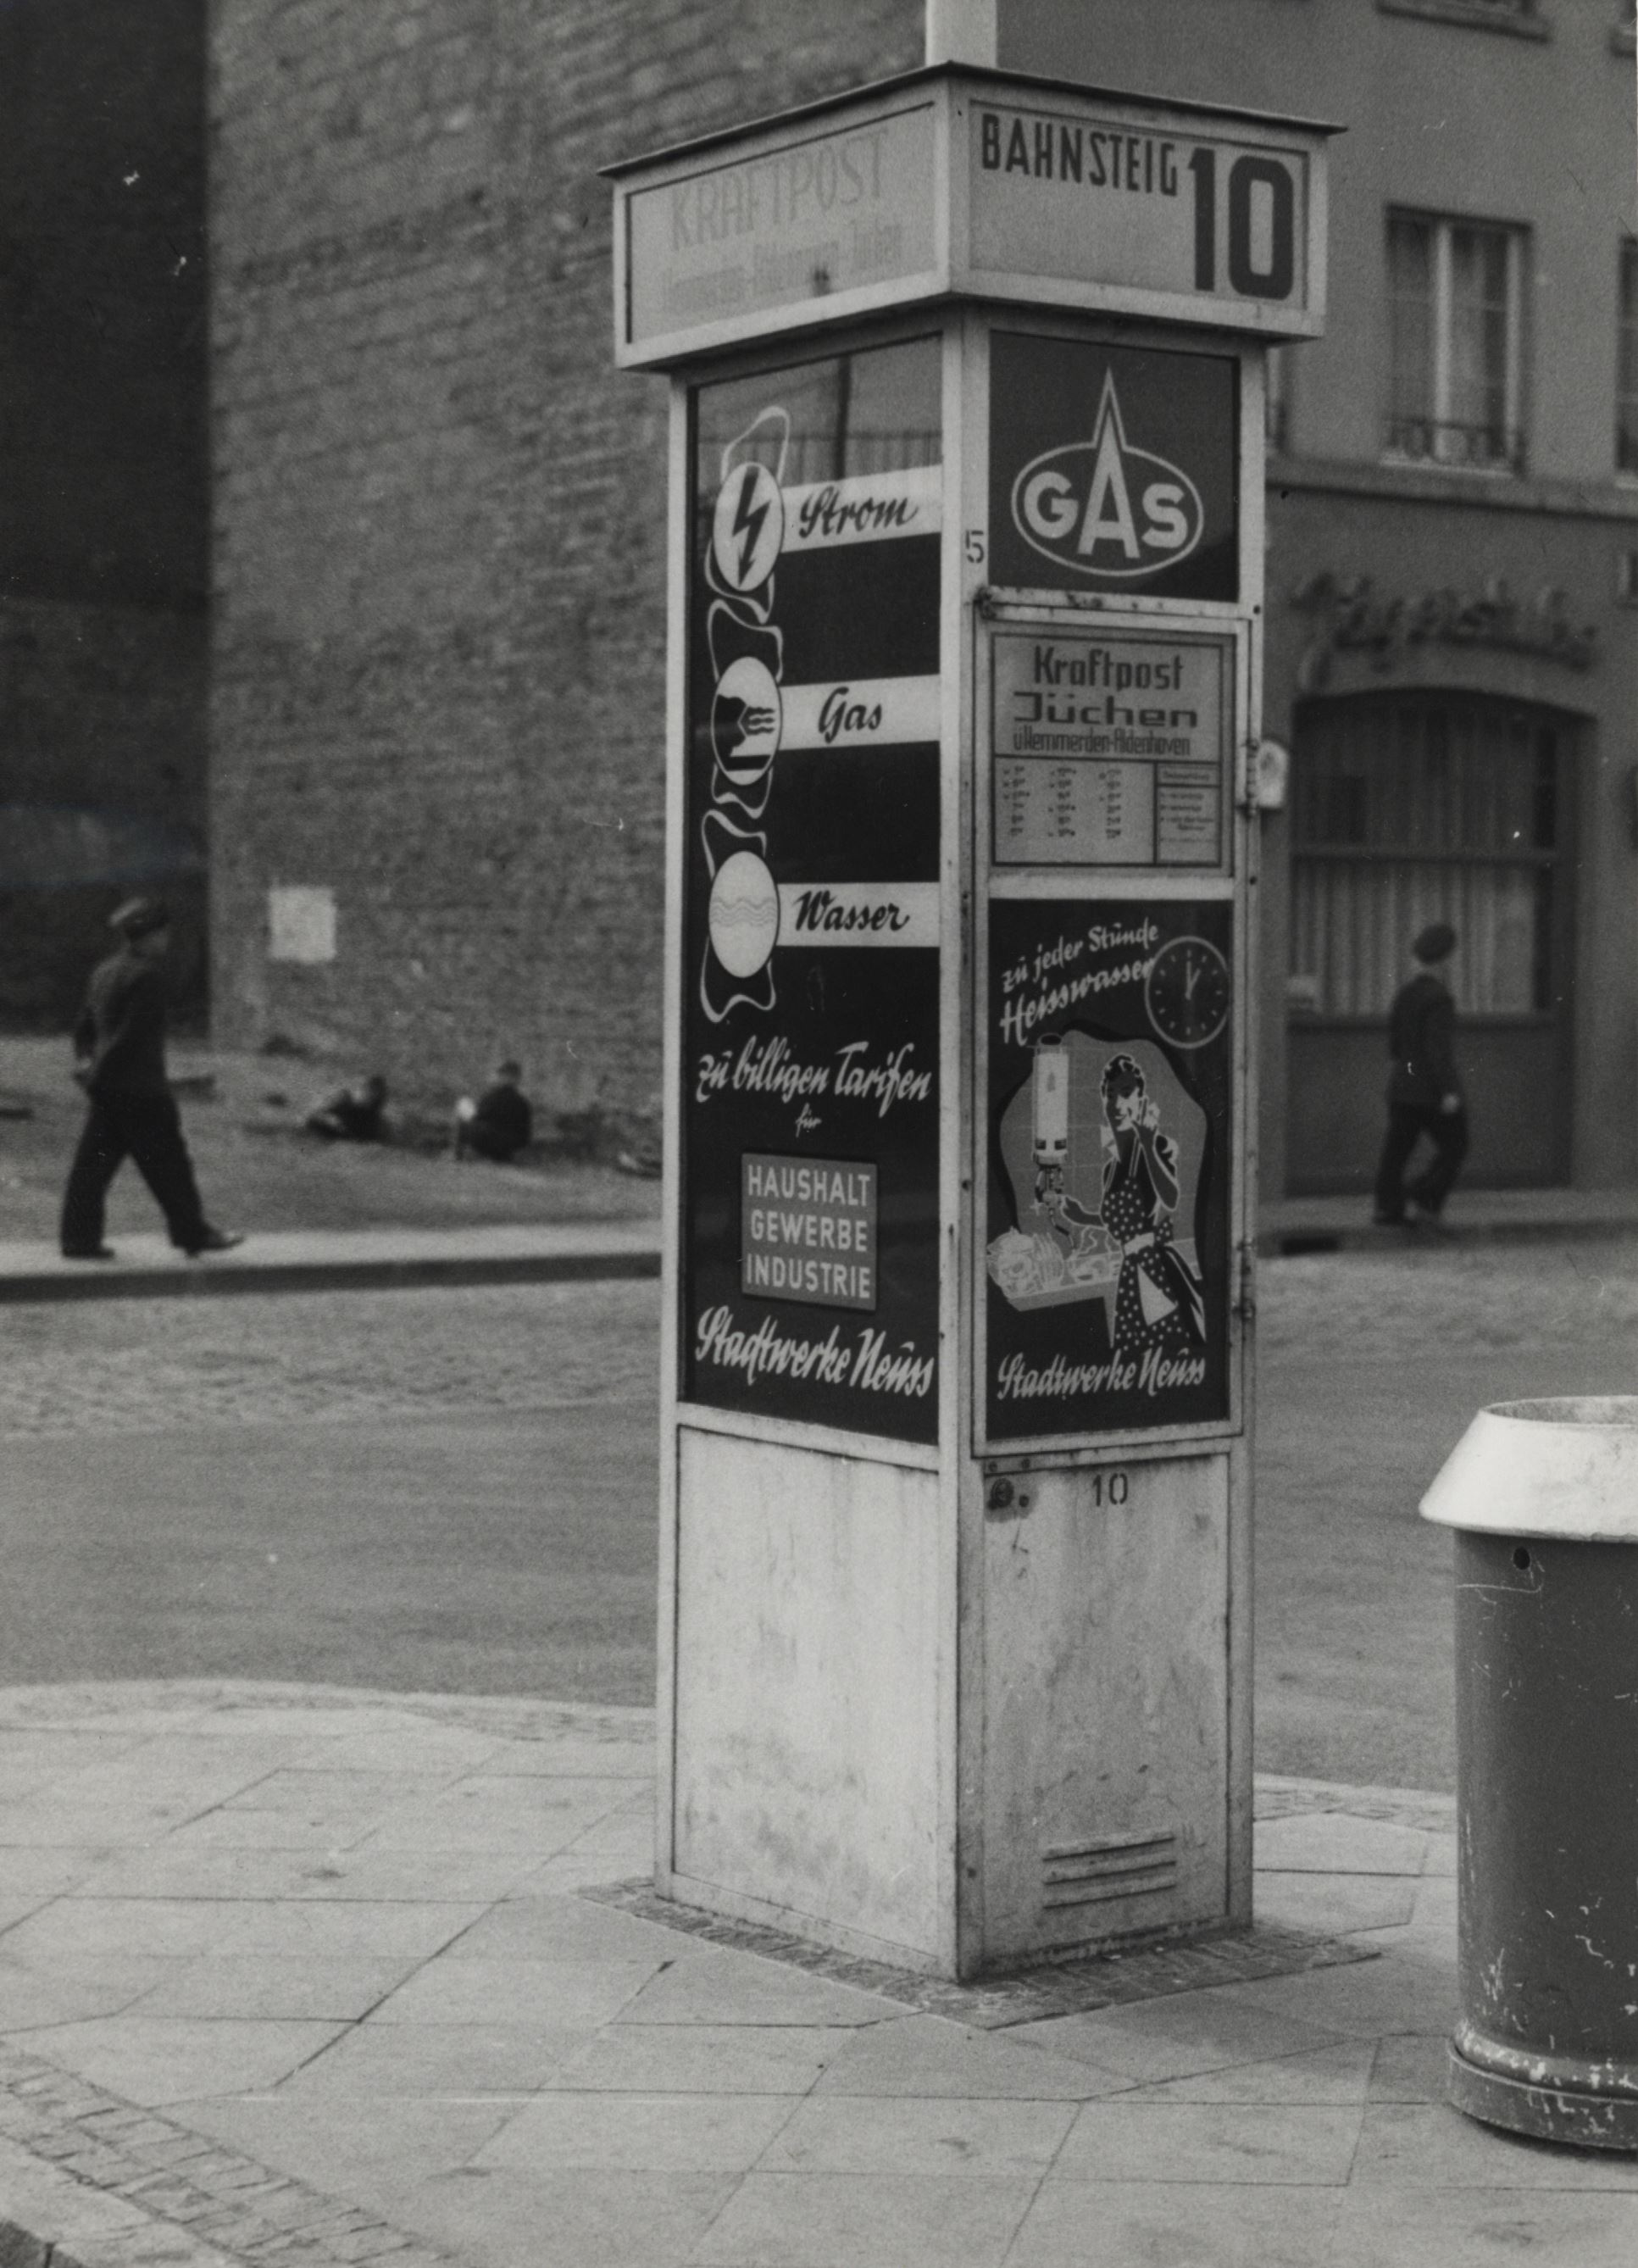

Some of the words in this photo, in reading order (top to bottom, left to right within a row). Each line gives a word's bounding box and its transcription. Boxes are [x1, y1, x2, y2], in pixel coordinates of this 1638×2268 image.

[670, 125, 889, 253] KRAFTPOST
[980, 112, 1178, 197] BAHNSTEIG
[1188, 147, 1294, 301] 10
[1023, 409, 1189, 559] GAS
[798, 485, 920, 539] Strom
[964, 530, 986, 564] 5
[1034, 645, 1184, 692] Kraftpost
[819, 687, 883, 744] Gas
[1013, 692, 1199, 729] Jüchen
[792, 889, 911, 931] Wasser
[1032, 935, 1084, 983] jeder
[999, 957, 1157, 1047] Heisswasser
[731, 1034, 830, 1103] billigen
[834, 1041, 933, 1119] Tarifen
[796, 1103, 822, 1137] für
[747, 1164, 871, 1208] HAUSHALT
[751, 1209, 868, 1253] GEWERBE
[747, 1253, 871, 1299] INDUSTRIE
[695, 1305, 852, 1386] Stadtwerke
[849, 1327, 934, 1397] Neuss
[997, 1348, 1137, 1400] Stadtwerke
[1137, 1345, 1206, 1397] Neuss
[1091, 1472, 1128, 1507] 10
